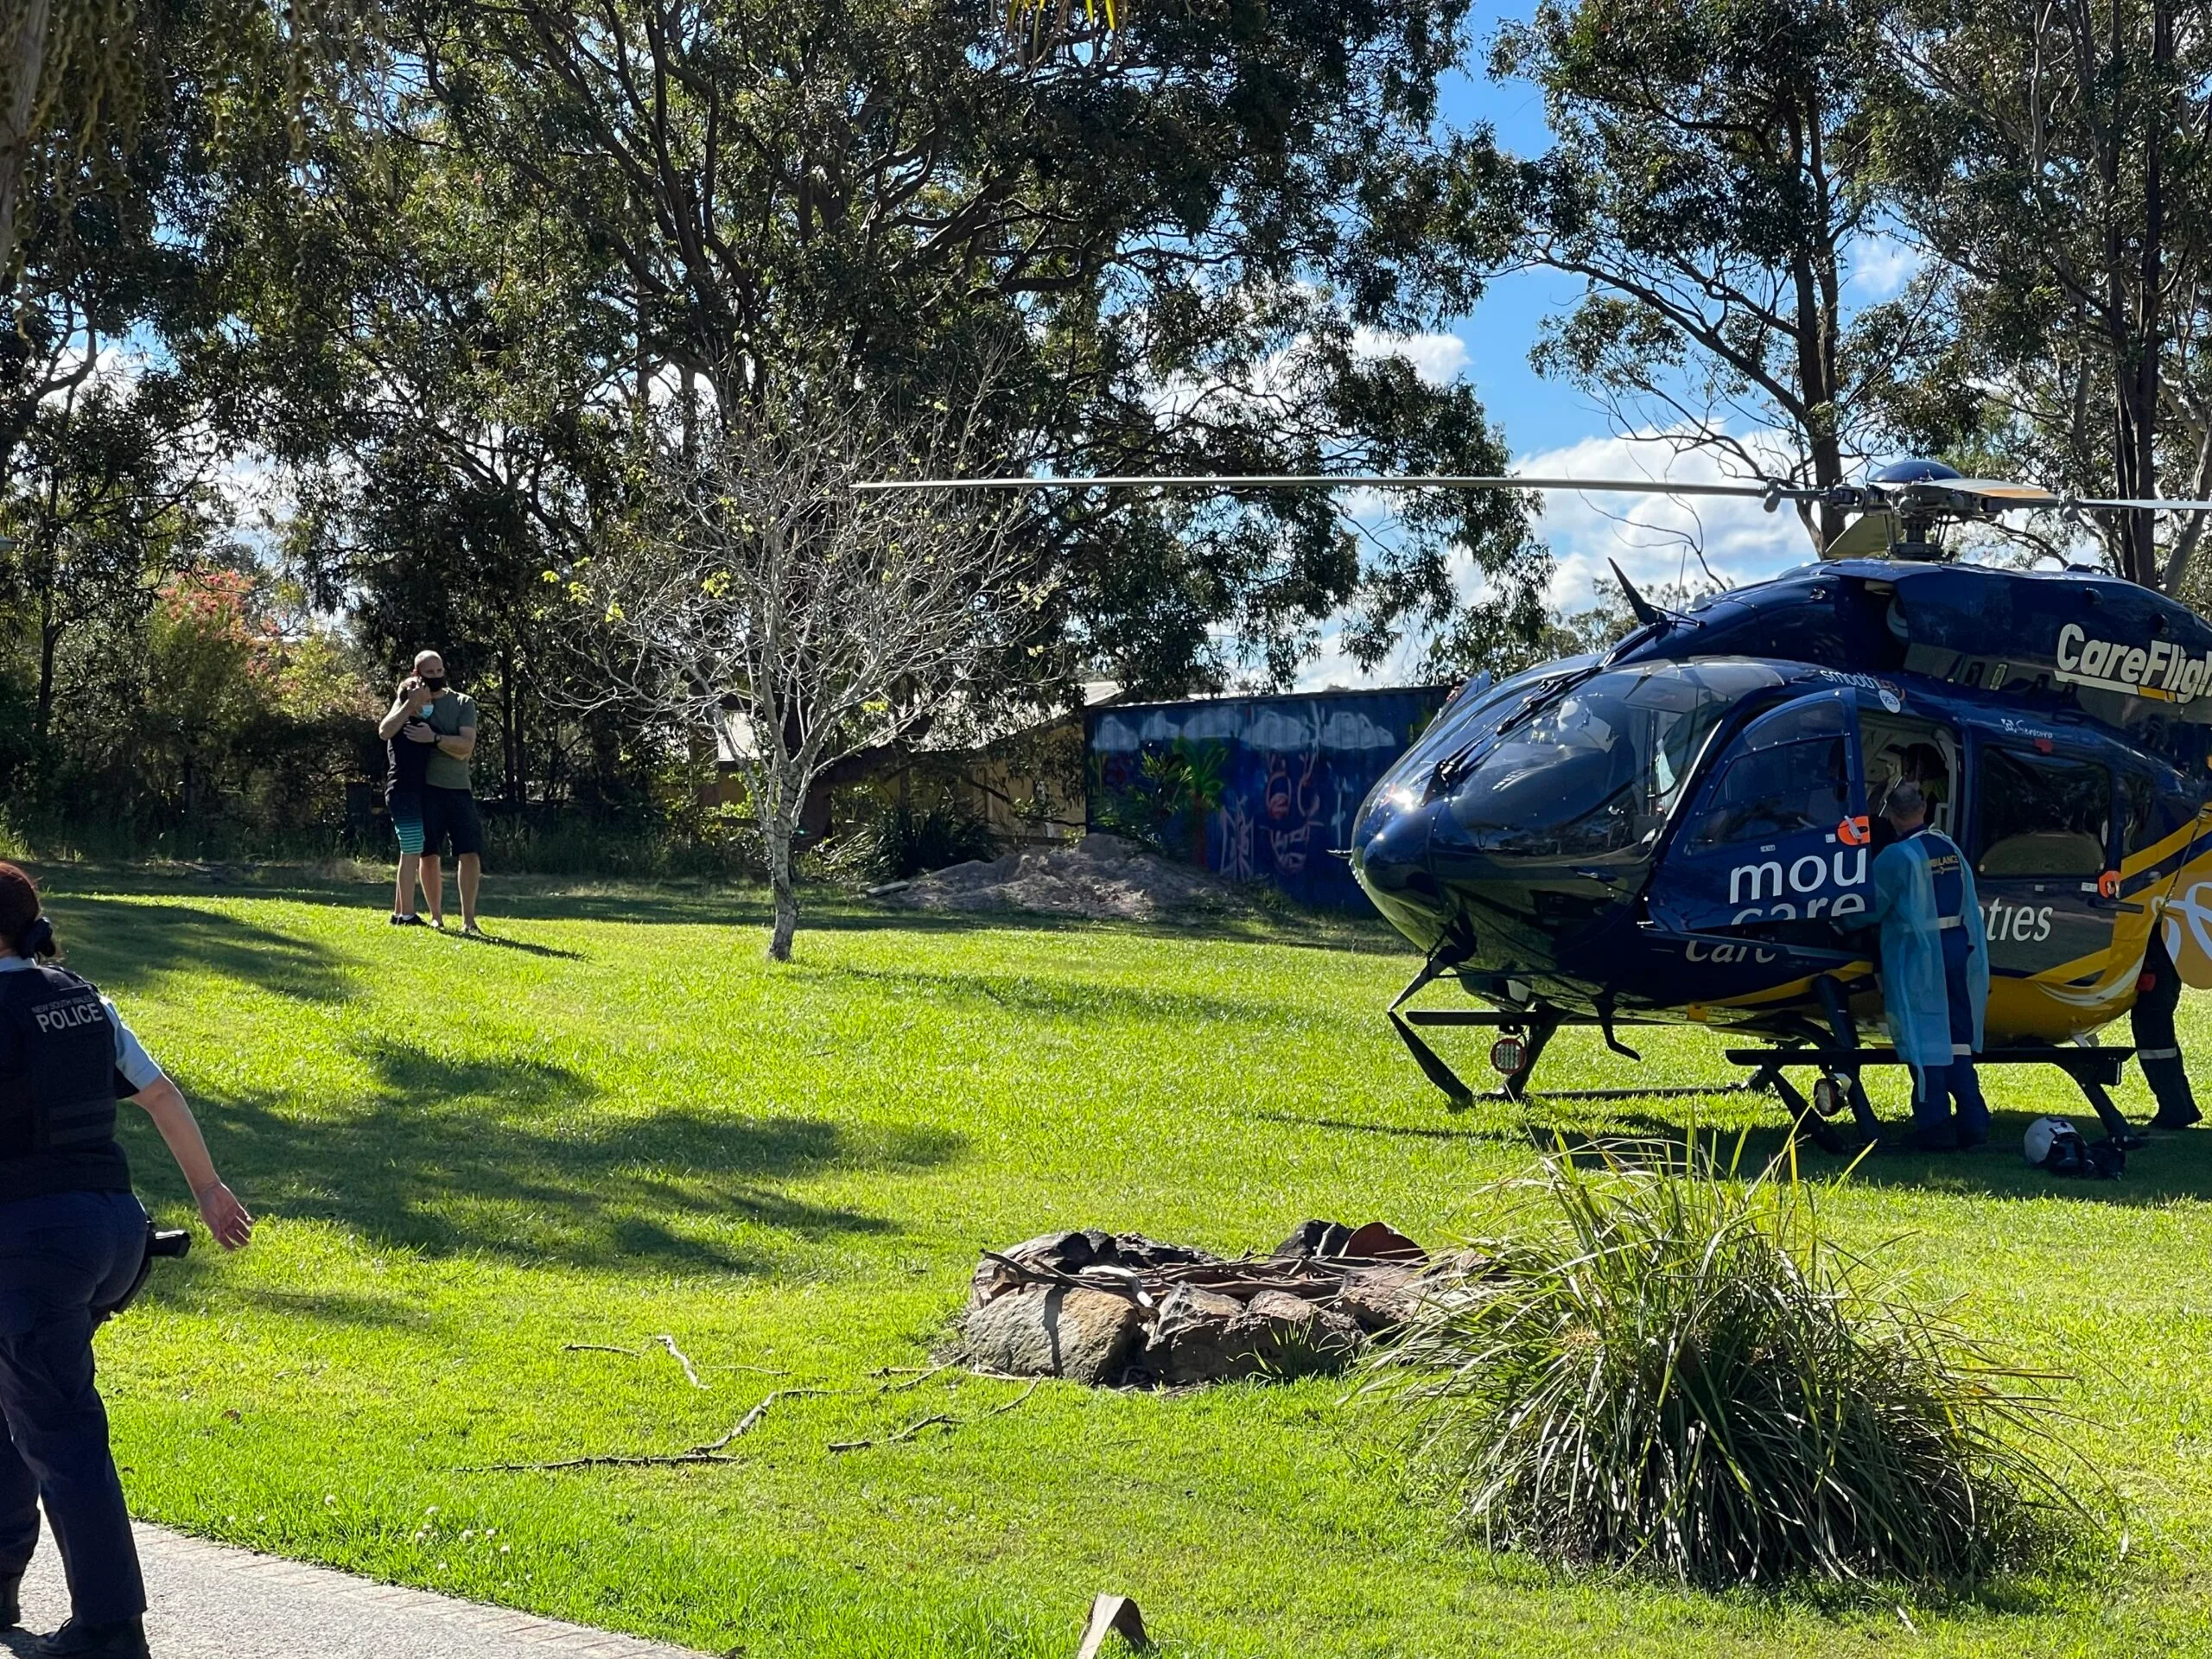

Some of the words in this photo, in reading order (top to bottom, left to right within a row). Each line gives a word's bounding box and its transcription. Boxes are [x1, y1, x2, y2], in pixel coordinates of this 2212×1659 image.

[1730, 849, 1866, 904] mou
[1978, 897, 2053, 942] ties
[36, 1003, 103, 1033] POLICE
[48, 999, 72, 1010] SOUTH
